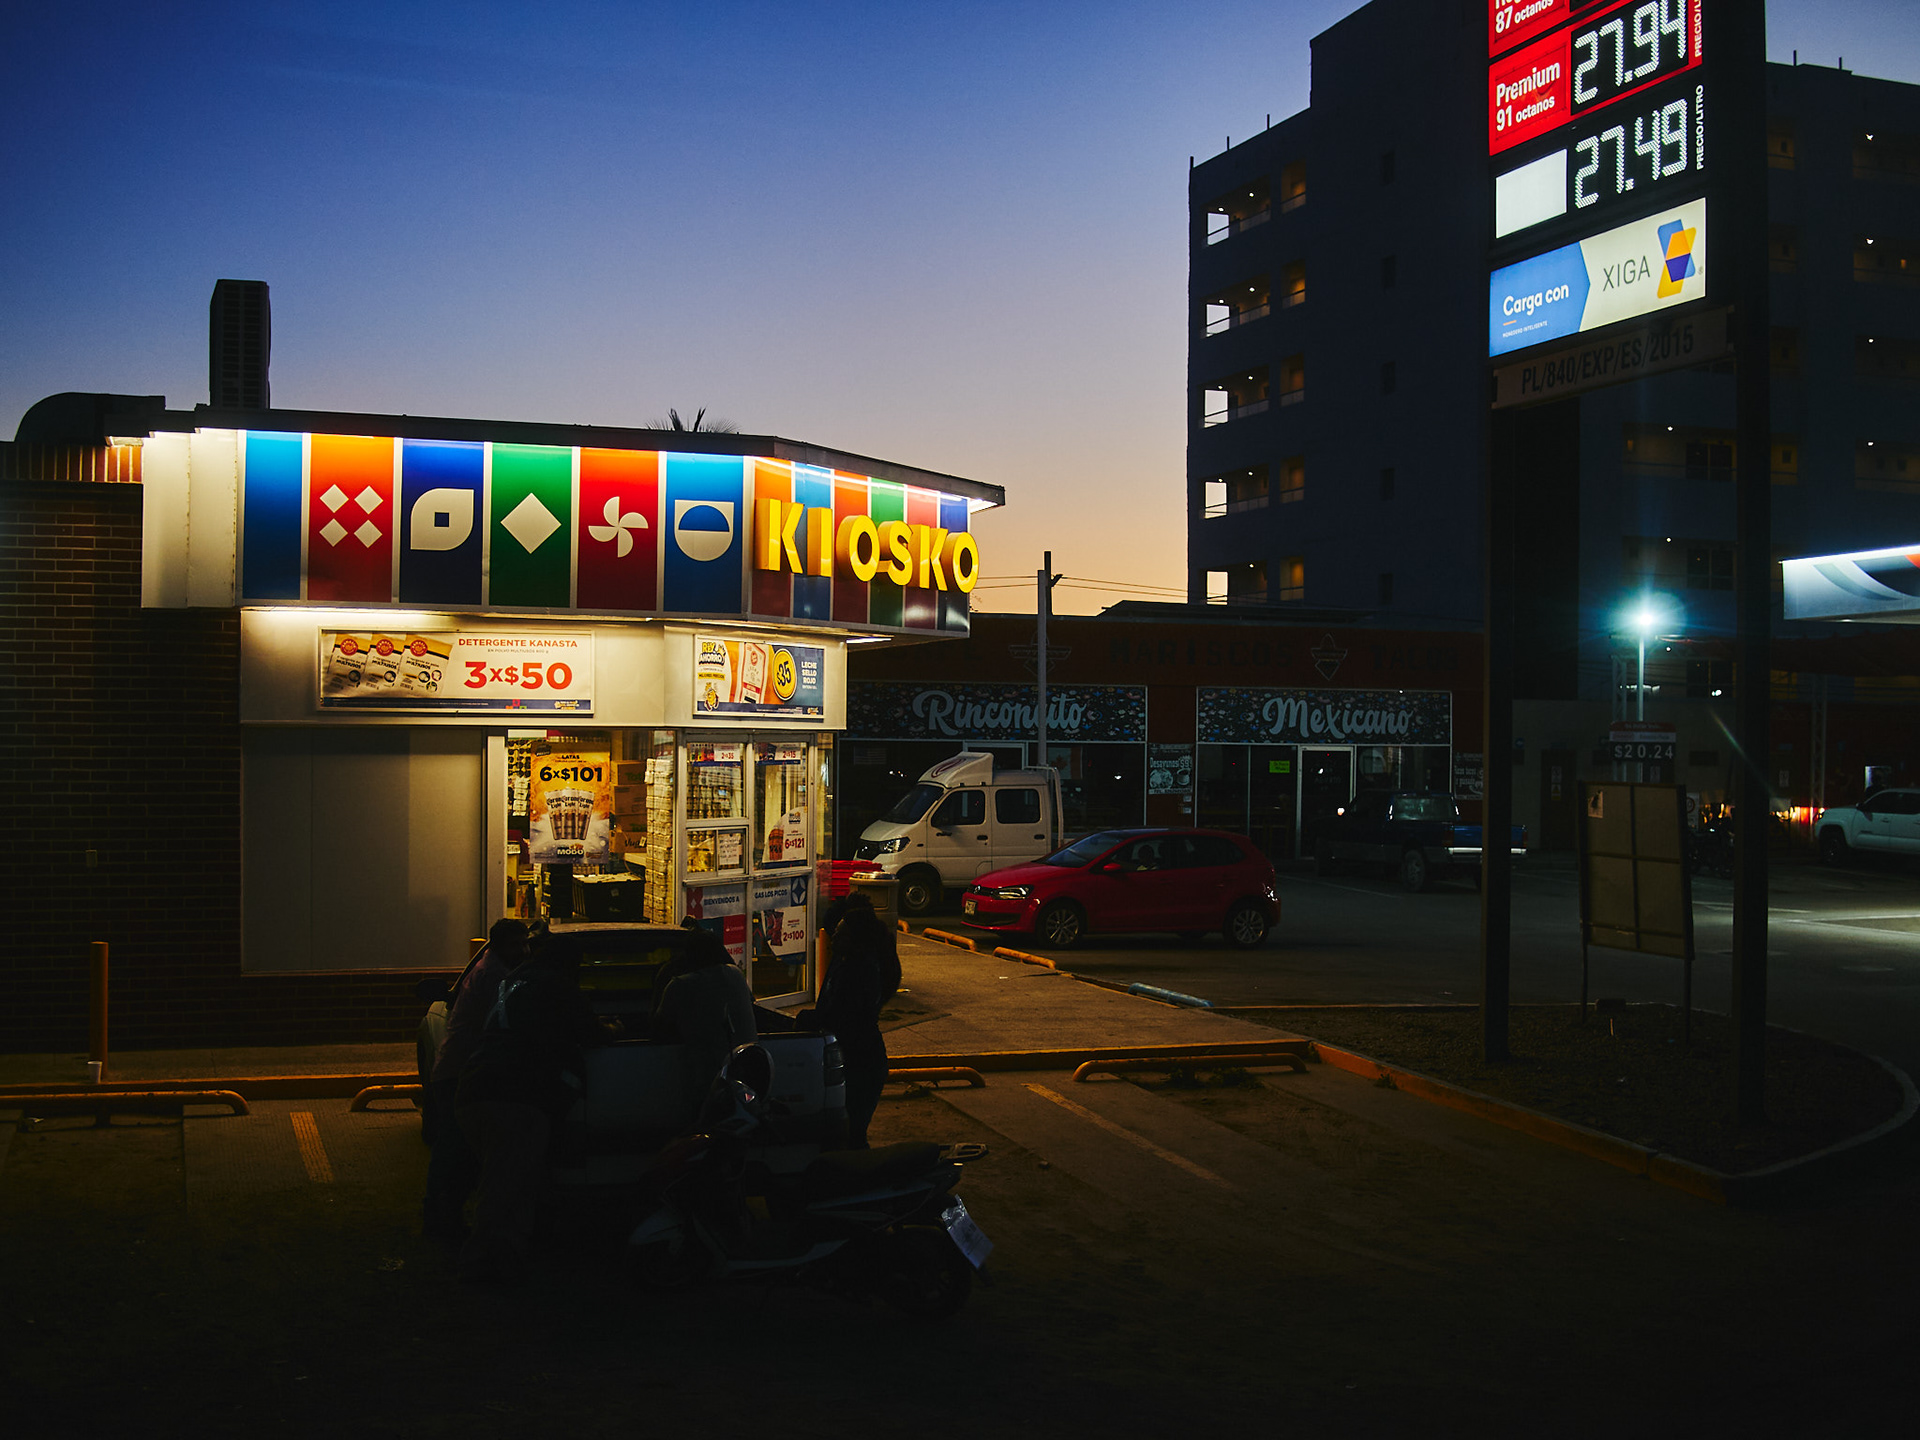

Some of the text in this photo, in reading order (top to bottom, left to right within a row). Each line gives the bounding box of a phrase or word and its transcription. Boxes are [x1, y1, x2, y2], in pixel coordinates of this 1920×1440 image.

[1495, 0, 1554, 33] 87 octanos
[1574, 0, 1687, 104] 27.94
[1496, 62, 1561, 106] Premium
[1496, 96, 1556, 131] 91 octanos
[1695, 84, 1704, 170] PRECIO/LITRO
[1575, 98, 1688, 208] 27.49
[1602, 255, 1651, 292] XIGA
[1503, 284, 1570, 316] Carga con
[1521, 324, 1694, 395] PL/840/EXP/ES/2015
[754, 498, 979, 594] KIOSKO
[458, 638, 578, 649] DETERGENTE KANASTA
[1109, 637, 1294, 667] MARISCOS
[463, 661, 573, 690] 3x$50
[777, 660, 792, 687] $35
[801, 661, 818, 669] LECHE
[801, 669, 817, 677] SELLO
[803, 677, 817, 685] ROJO
[1262, 697, 1414, 740] Mexicano
[540, 766, 602, 782] 6x$101
[703, 897, 735, 905] BIENVENIDOS
[754, 888, 788, 899] GAS LOS PICOS
